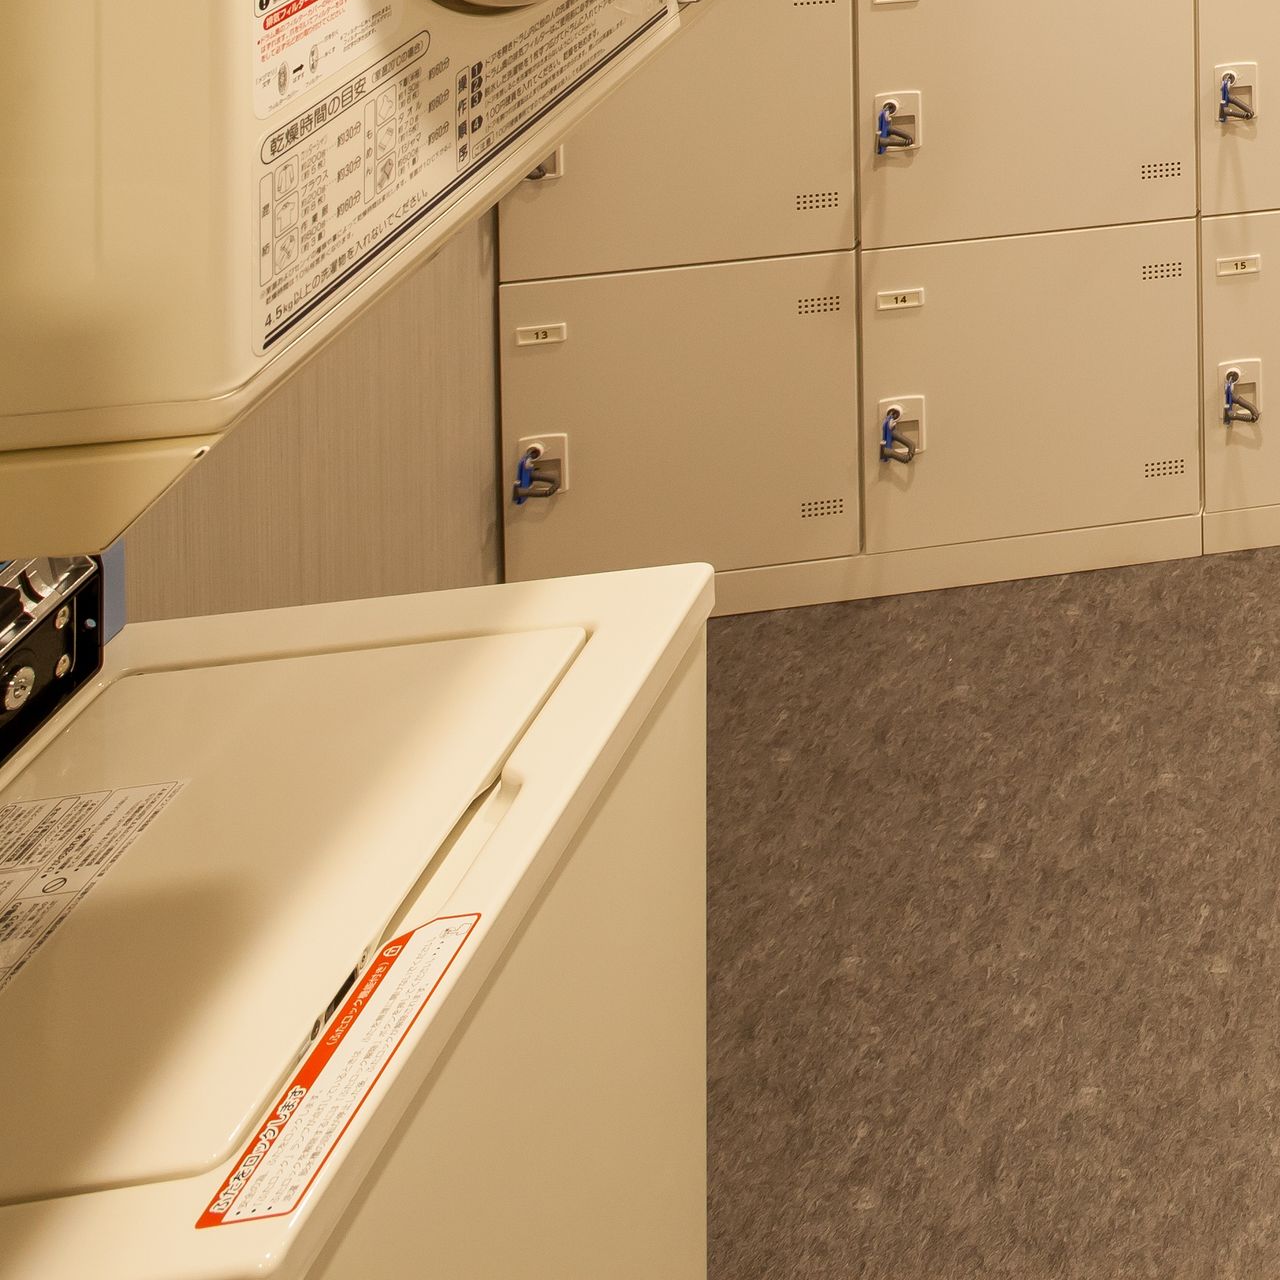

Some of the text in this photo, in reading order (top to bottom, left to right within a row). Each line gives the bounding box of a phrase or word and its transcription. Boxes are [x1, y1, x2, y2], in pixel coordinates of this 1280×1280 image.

[270, 77, 366, 157] 乾燥時間の目安
[1234, 261, 1247, 271] 15
[893, 295, 907, 305] 14
[534, 330, 549, 340] 13
[210, 1085, 307, 1212] ふたをロックします
